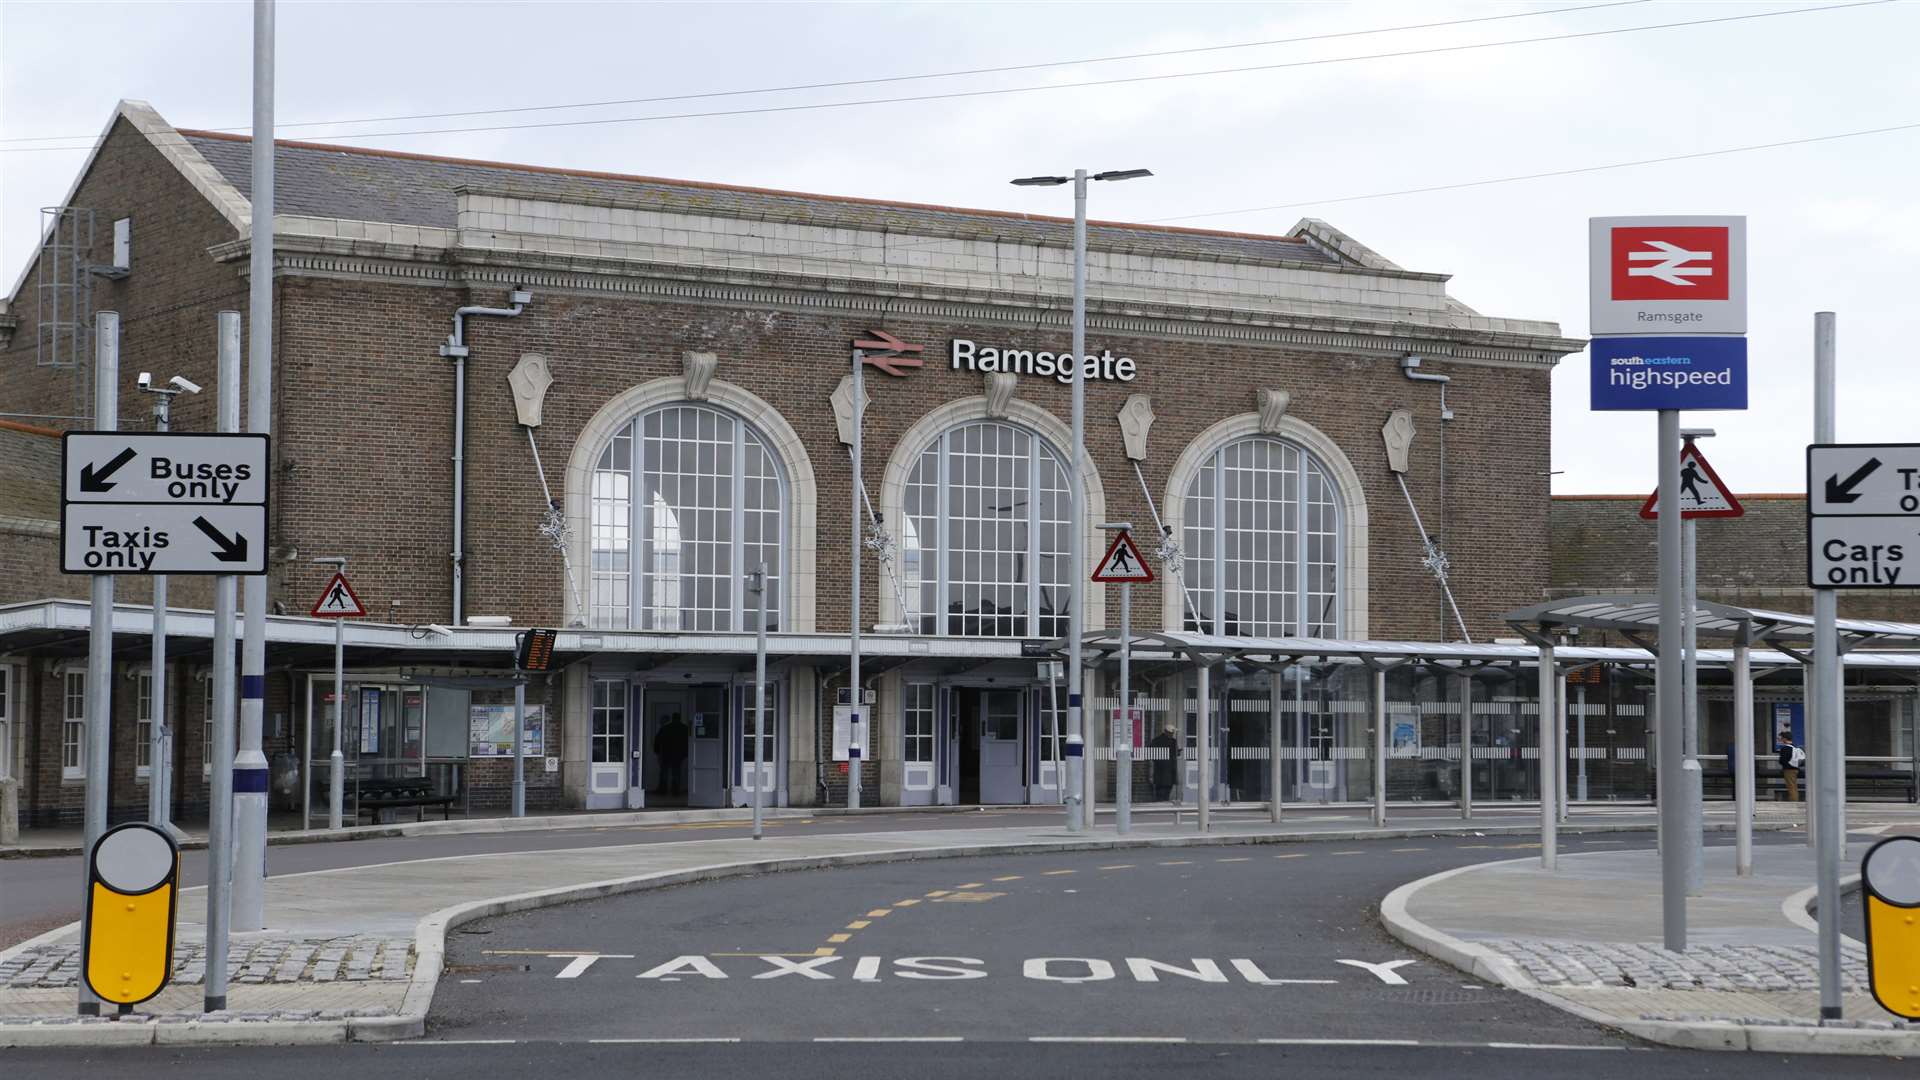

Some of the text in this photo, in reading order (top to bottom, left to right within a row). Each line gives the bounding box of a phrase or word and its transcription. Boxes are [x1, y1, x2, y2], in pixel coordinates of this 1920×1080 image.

[1637, 311, 1703, 324] Ramsgate
[952, 338, 1137, 384] Ramsgate
[1610, 367, 1732, 390] highspeed
[151, 457, 252, 481] Buses
[1896, 468, 1920, 491] T
[167, 476, 240, 503] only
[82, 525, 170, 549] Taxis
[84, 545, 157, 571] only
[1822, 538, 1904, 562] Cars
[1827, 561, 1902, 585] only
[547, 954, 1417, 985] TAXIS ONLY
